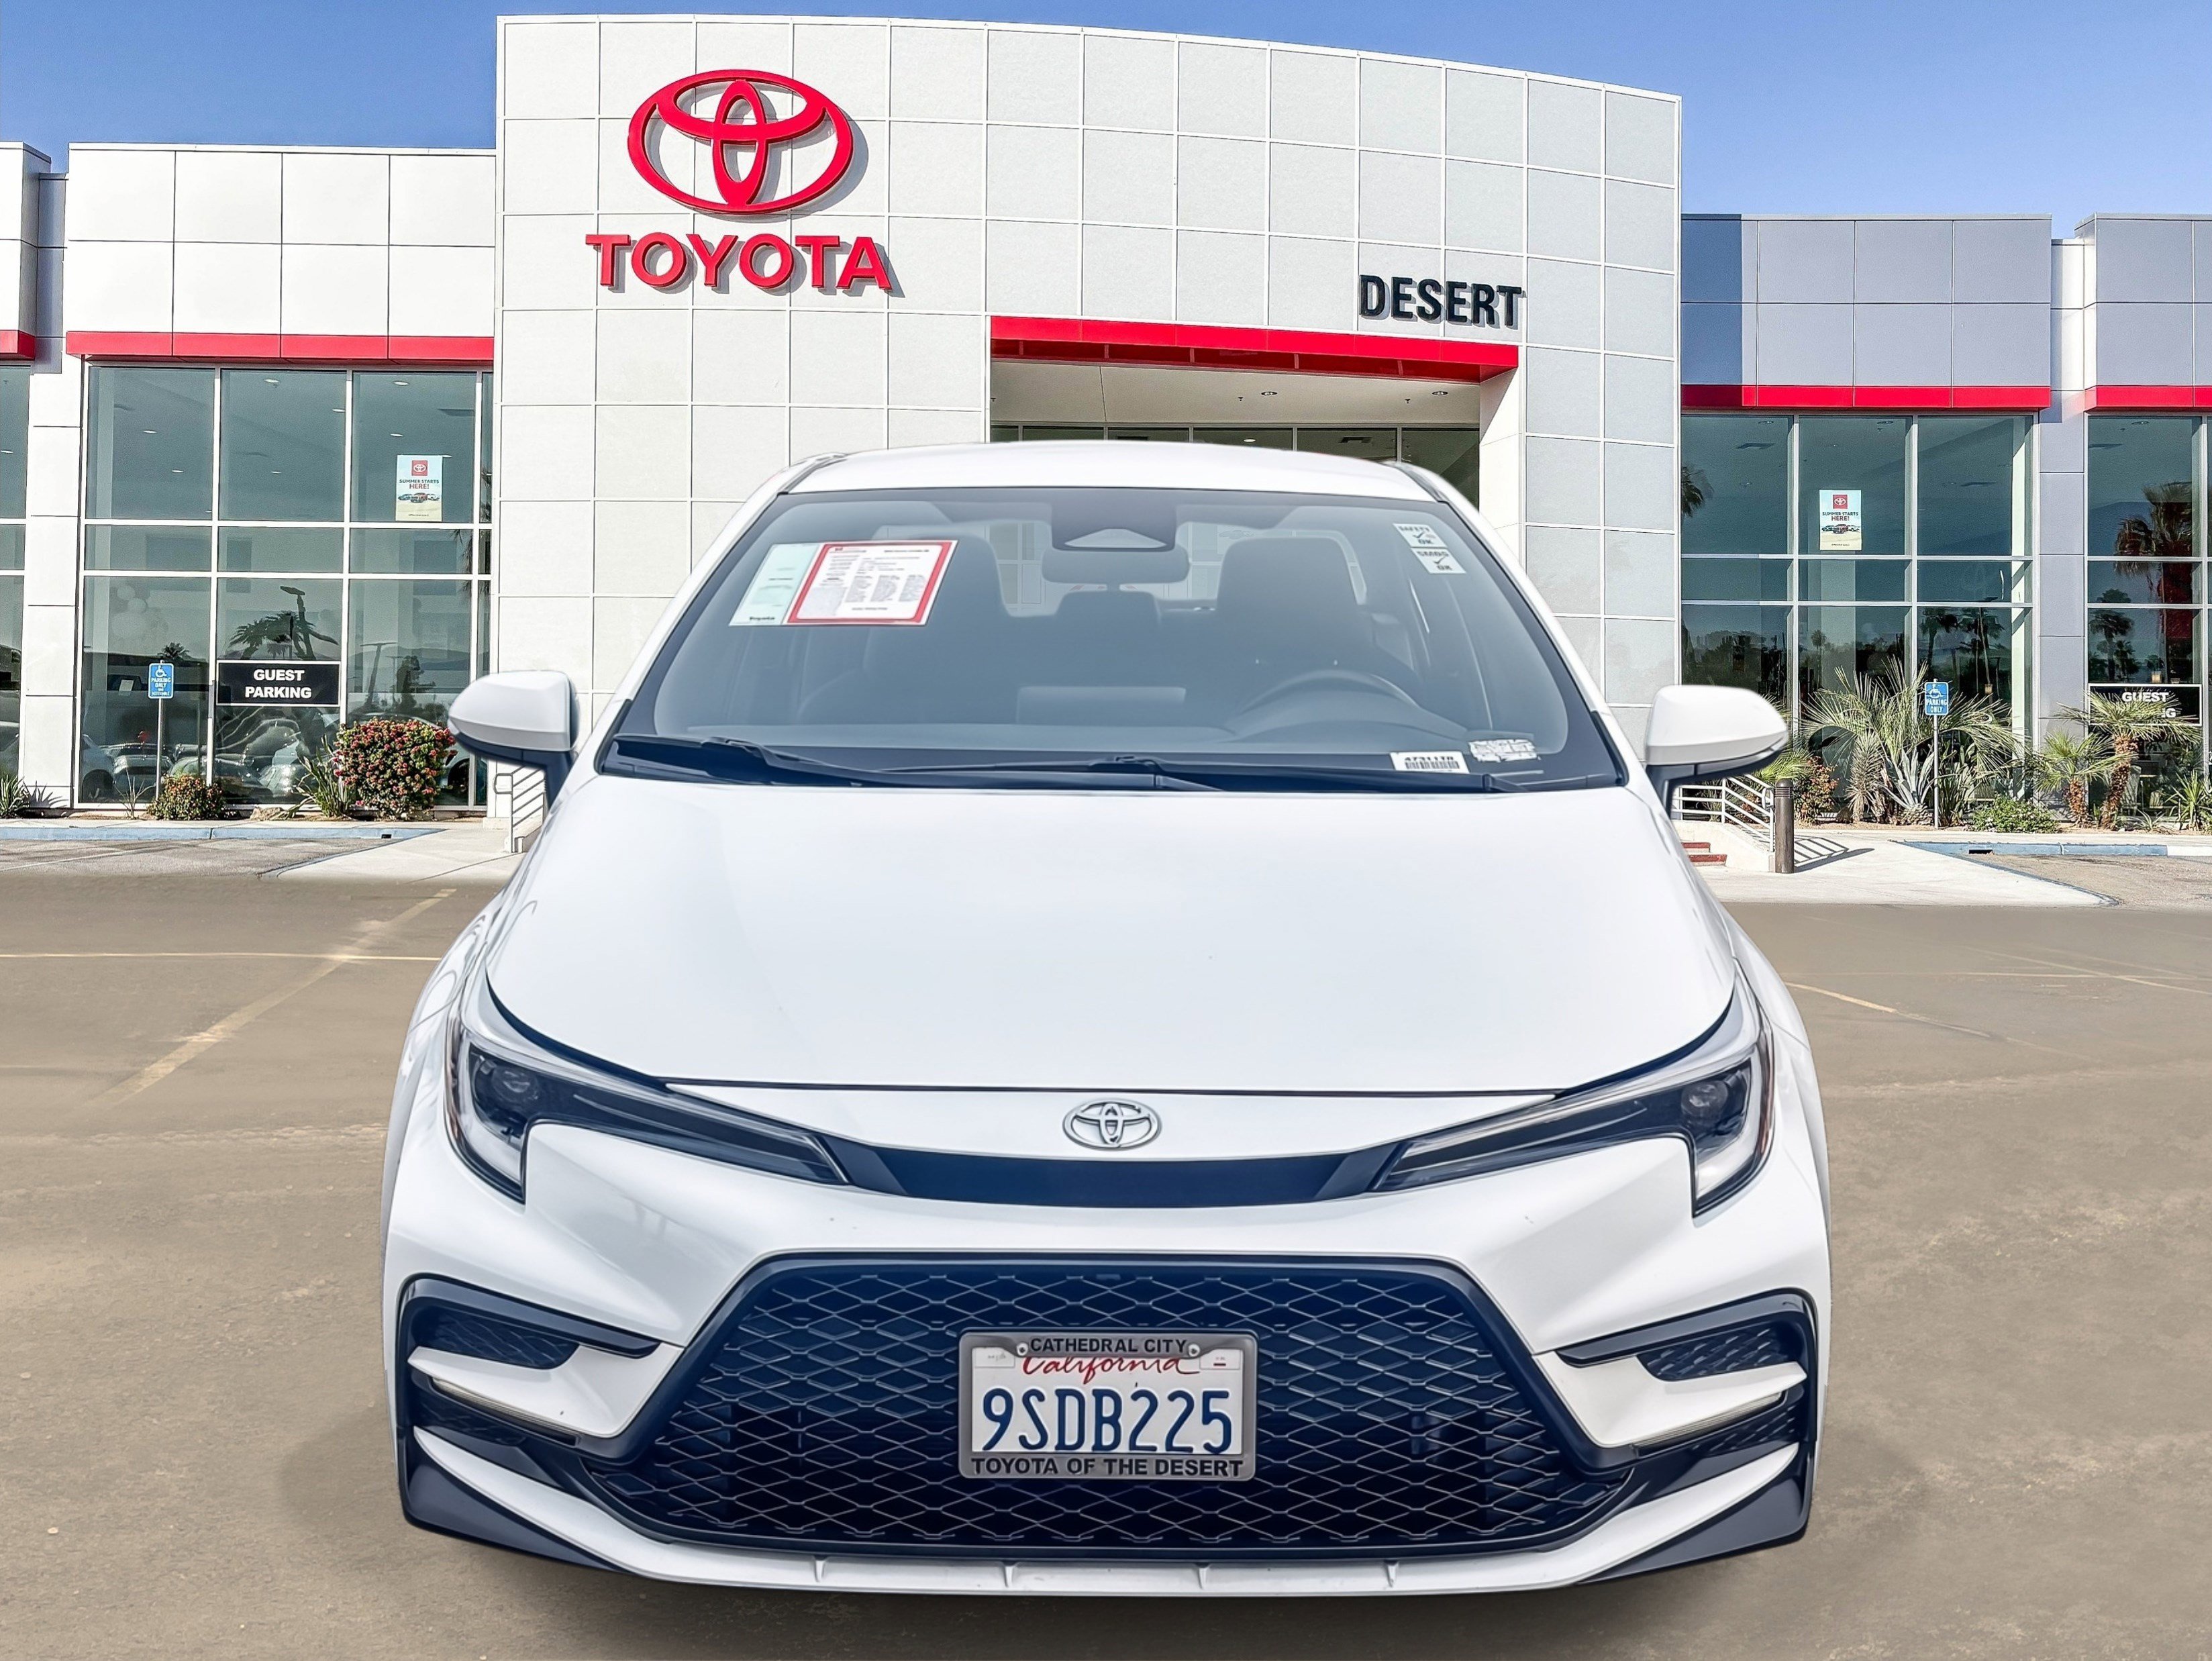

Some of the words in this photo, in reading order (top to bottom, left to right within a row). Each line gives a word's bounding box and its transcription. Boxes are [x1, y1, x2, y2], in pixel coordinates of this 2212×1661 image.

[586, 232, 893, 291] TOYOTA
[1359, 274, 1523, 326] DESERT
[253, 669, 305, 681] GUEST
[245, 686, 312, 699] PARKING
[2121, 692, 2169, 703] GUEST
[1030, 1338, 1138, 1352] CATHEDRAL
[1144, 1339, 1187, 1353] CITY
[1022, 1356, 1200, 1385] California
[982, 1388, 1231, 1454] 9SDB225
[971, 1458, 1058, 1474] TOYOTA
[1067, 1458, 1096, 1474] OF
[1104, 1459, 1148, 1475] THE
[1154, 1459, 1244, 1476] DESERT
